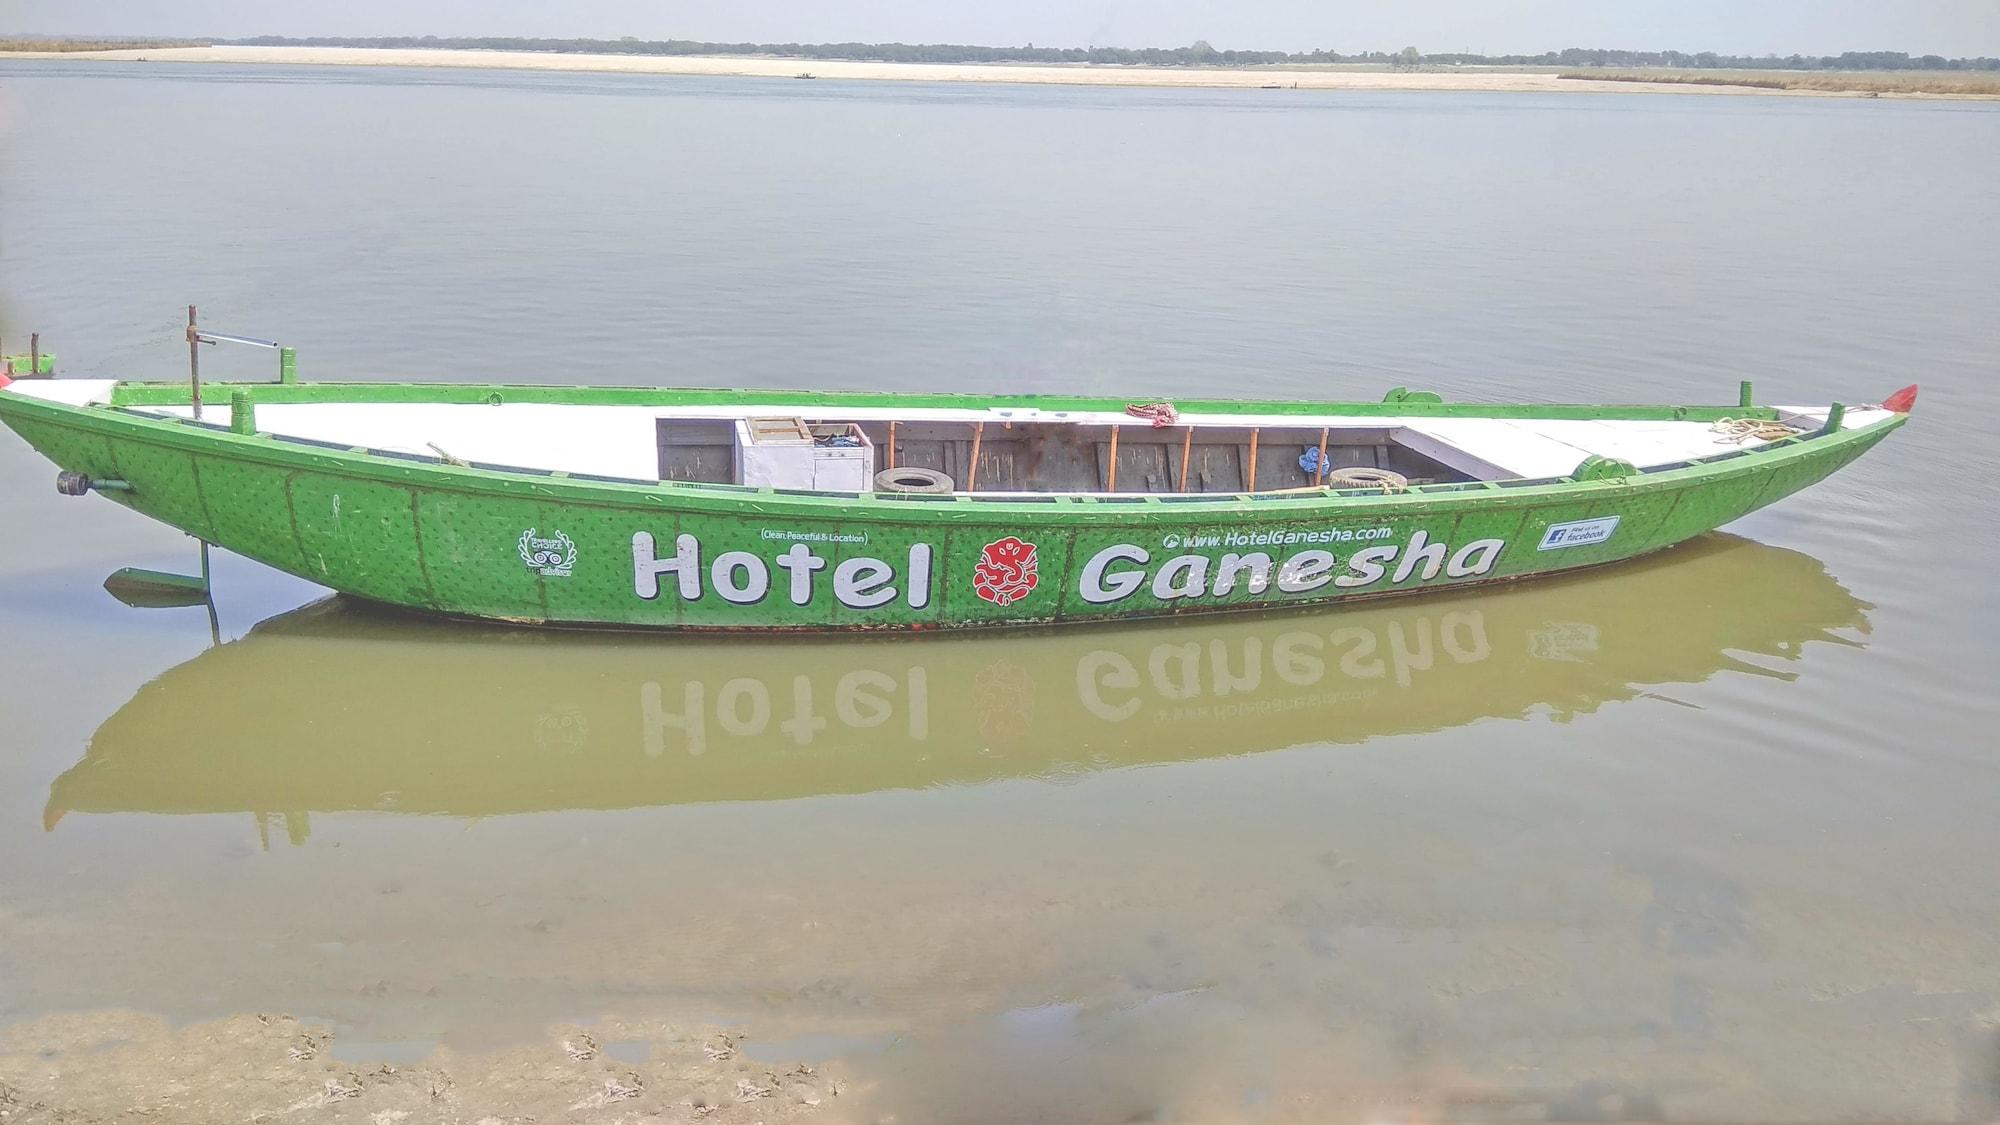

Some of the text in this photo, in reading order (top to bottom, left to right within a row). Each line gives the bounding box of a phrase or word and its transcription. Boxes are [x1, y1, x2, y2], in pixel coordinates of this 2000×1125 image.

[787, 531, 820, 541] Peaceful
[1225, 526, 1393, 546] HotelGanesha.com
[1567, 530, 1605, 541] facebook
[632, 530, 1506, 610] Hotel Ganesha
